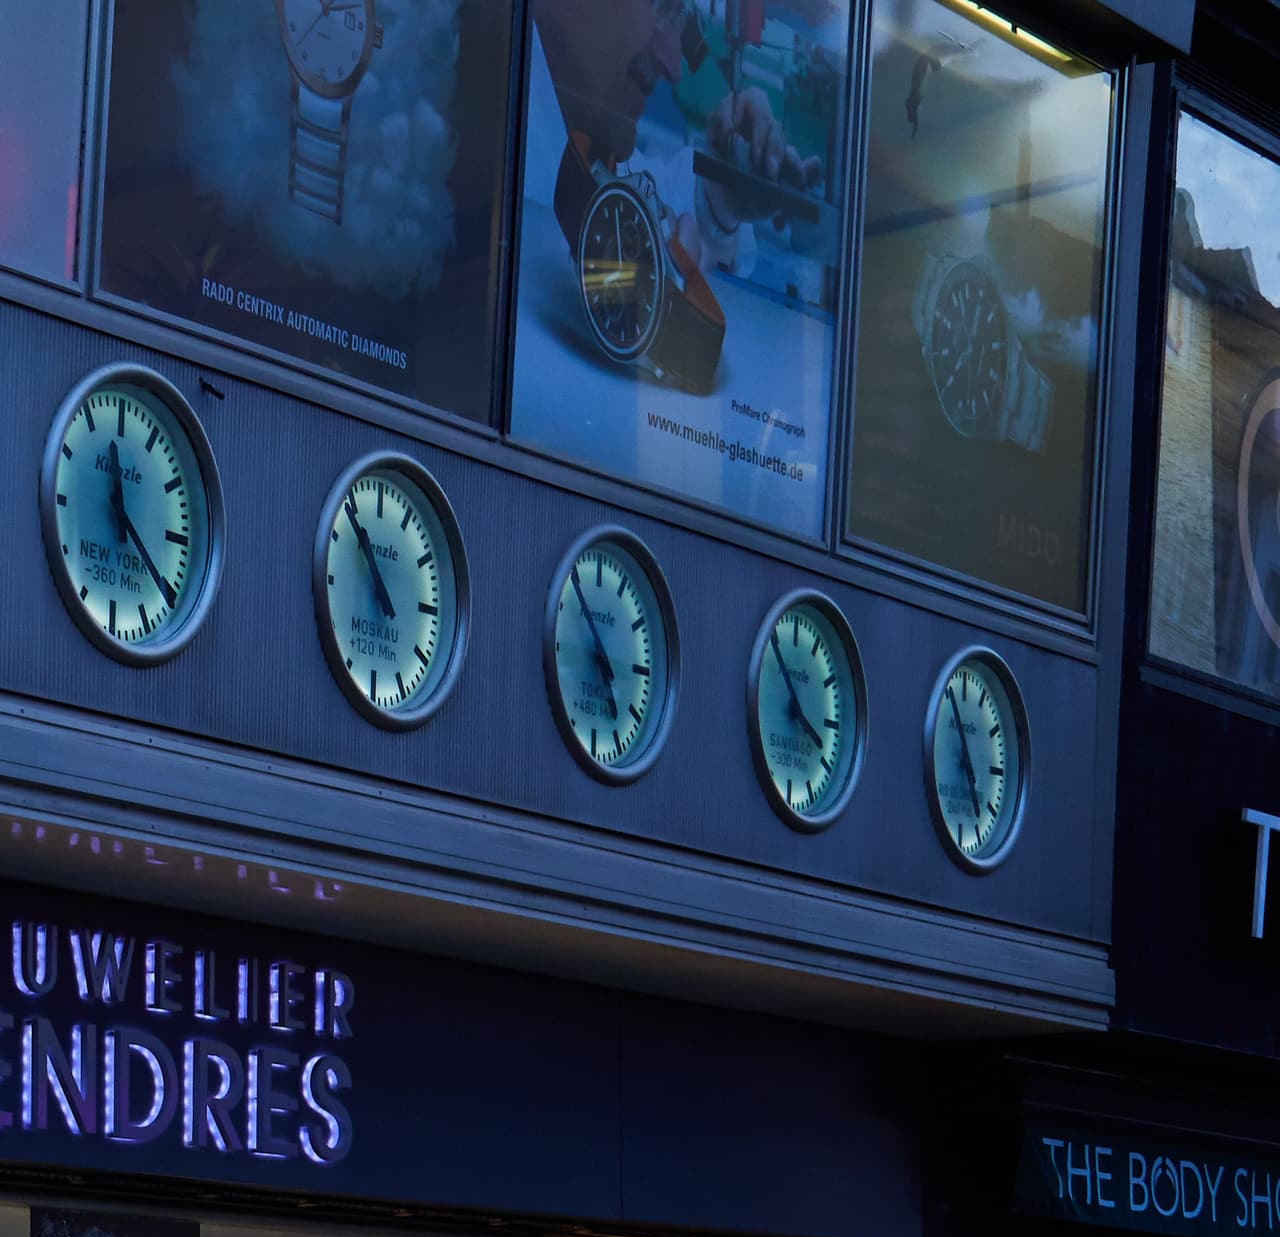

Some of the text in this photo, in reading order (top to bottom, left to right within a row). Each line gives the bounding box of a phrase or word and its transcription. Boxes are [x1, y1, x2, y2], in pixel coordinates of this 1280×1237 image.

[202, 278, 407, 369] RADO CENTRIX AUTOMATIC DIAMONDS
[647, 412, 804, 482] www.muehle-glashuette.de
[80, 538, 111, 563] NEW
[998, 511, 1061, 567] MIDO
[350, 637, 375, 657] +120
[351, 615, 399, 644] MOSKAU
[769, 733, 813, 757] SANTIAGO
[1041, 1136, 1280, 1230] THE BODY SH
